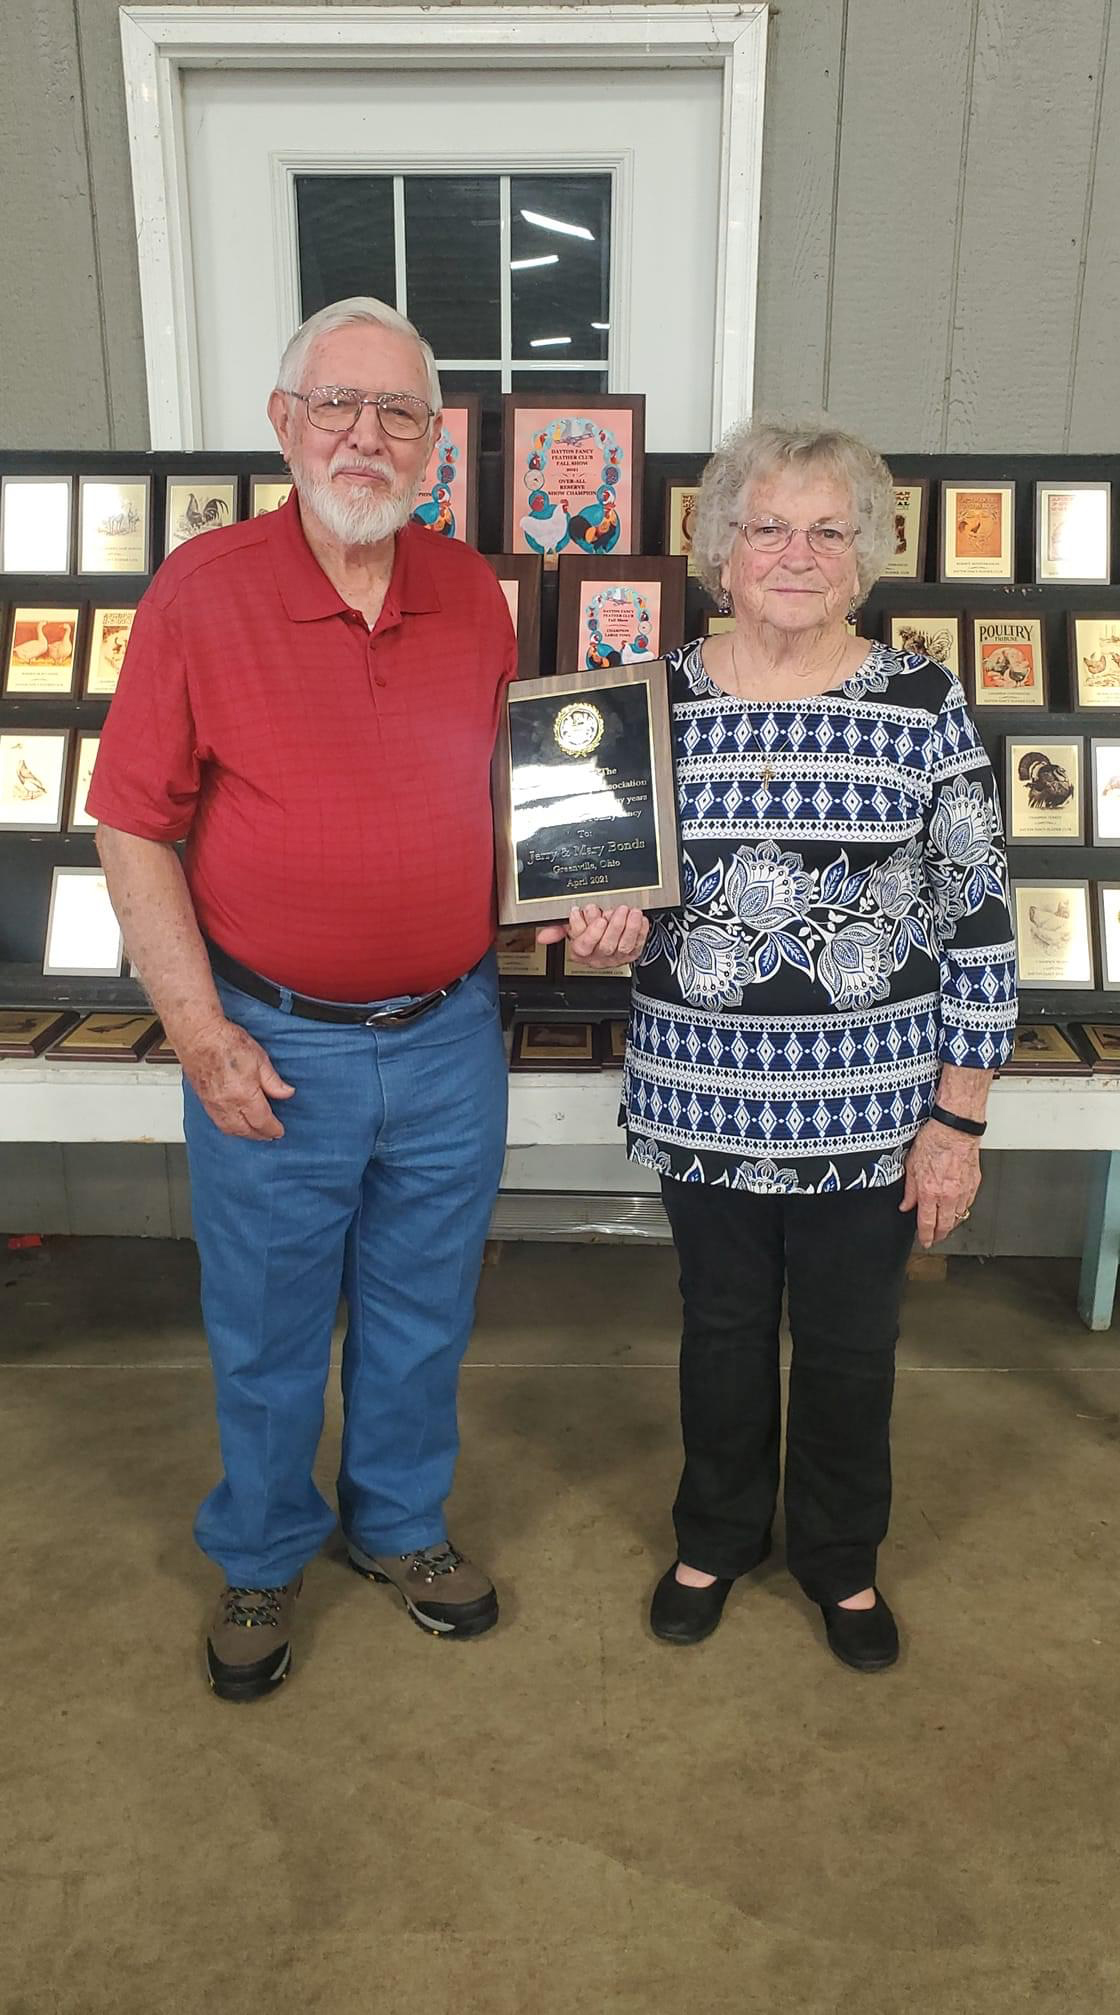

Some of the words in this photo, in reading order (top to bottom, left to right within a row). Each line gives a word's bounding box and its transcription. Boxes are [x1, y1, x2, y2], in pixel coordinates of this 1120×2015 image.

[979, 624, 1034, 642] POULTRY
[577, 829, 593, 839] To:
[527, 849, 558, 865] Jerry
[560, 847, 571, 858] &
[573, 843, 605, 857] Mary
[607, 837, 646, 853] Bonds
[599, 858, 621, 869] Ohio
[566, 876, 589, 889] April
[590, 875, 609, 885] 2021
